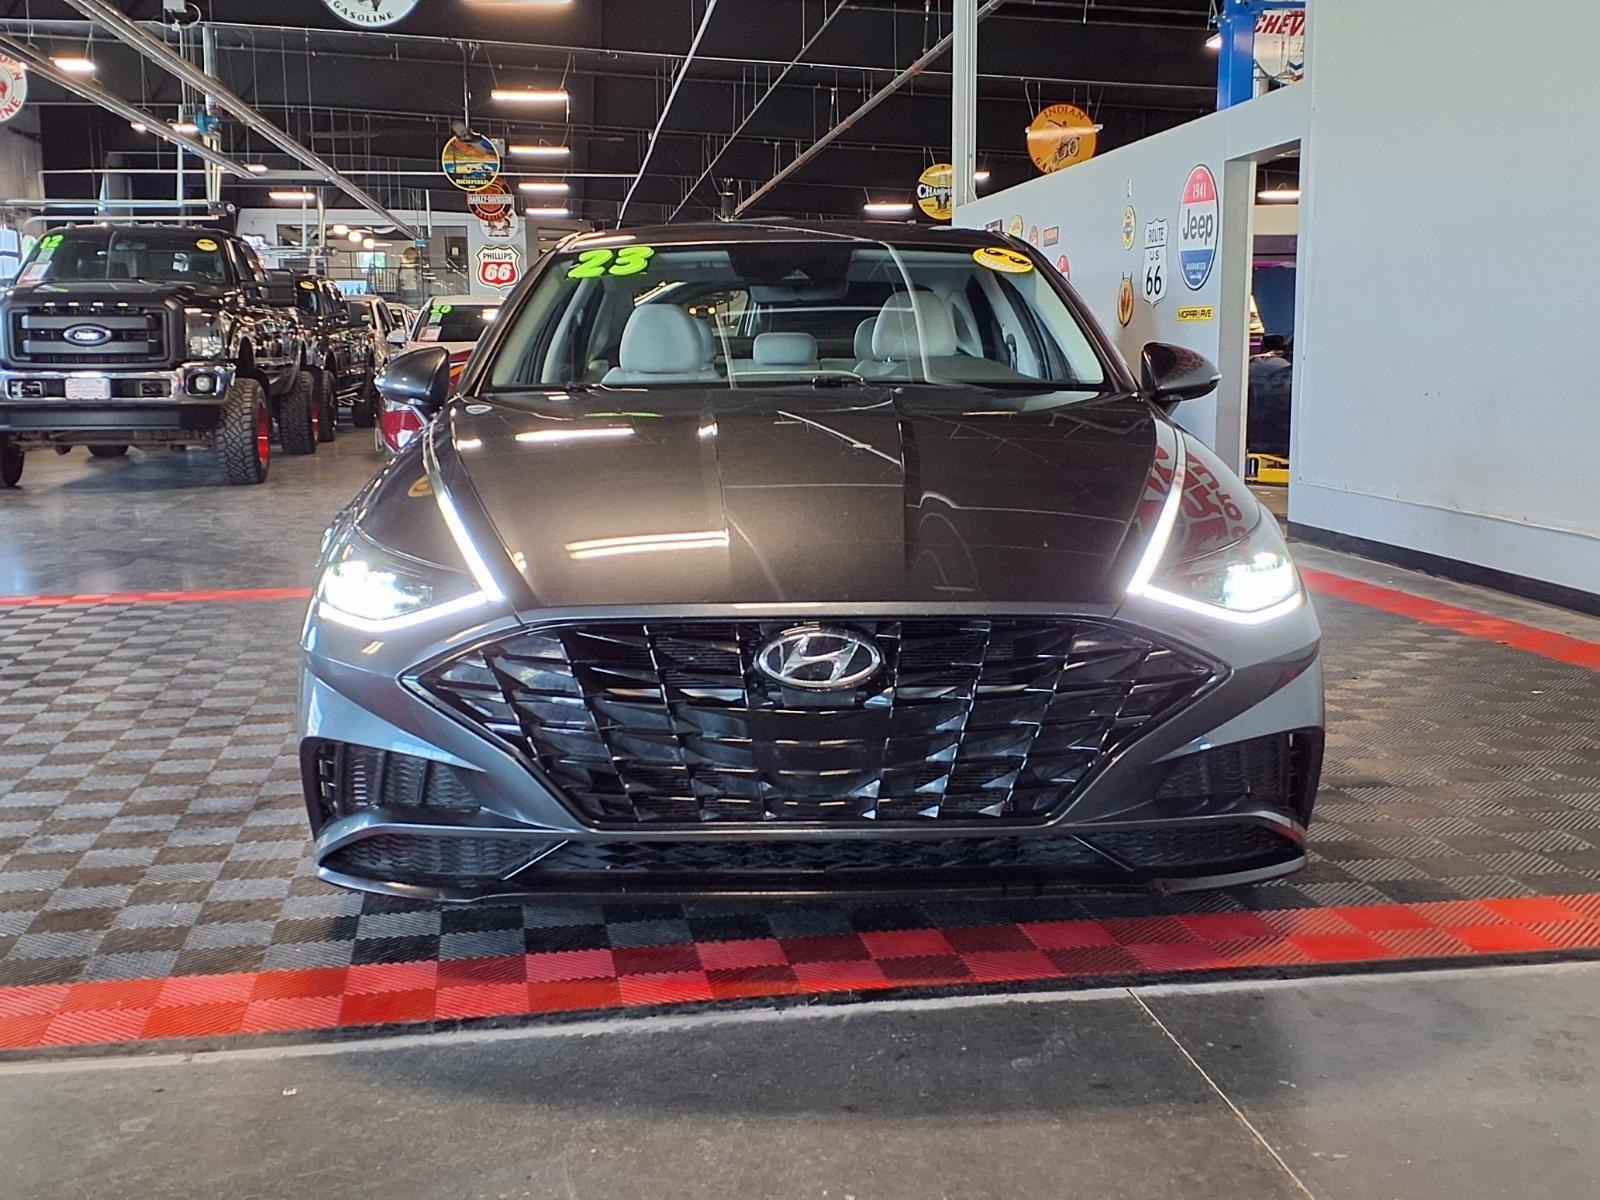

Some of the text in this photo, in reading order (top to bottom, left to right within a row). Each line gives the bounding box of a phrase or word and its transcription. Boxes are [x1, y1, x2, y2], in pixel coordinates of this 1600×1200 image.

[333, 0, 394, 22] GASOLINE
[1254, 14, 1305, 37] CHEV
[1043, 106, 1086, 121] INDIAN
[1191, 181, 1207, 199] 1941
[1148, 226, 1164, 243] ROUTE
[1182, 209, 1214, 245] Jeep
[40, 234, 65, 249] 12
[482, 252, 513, 260] PHILLIPS
[566, 246, 655, 278] 23
[1149, 249, 1160, 261] US
[484, 263, 512, 281] 66
[1145, 265, 1162, 296] 66
[430, 304, 453, 314] 20
